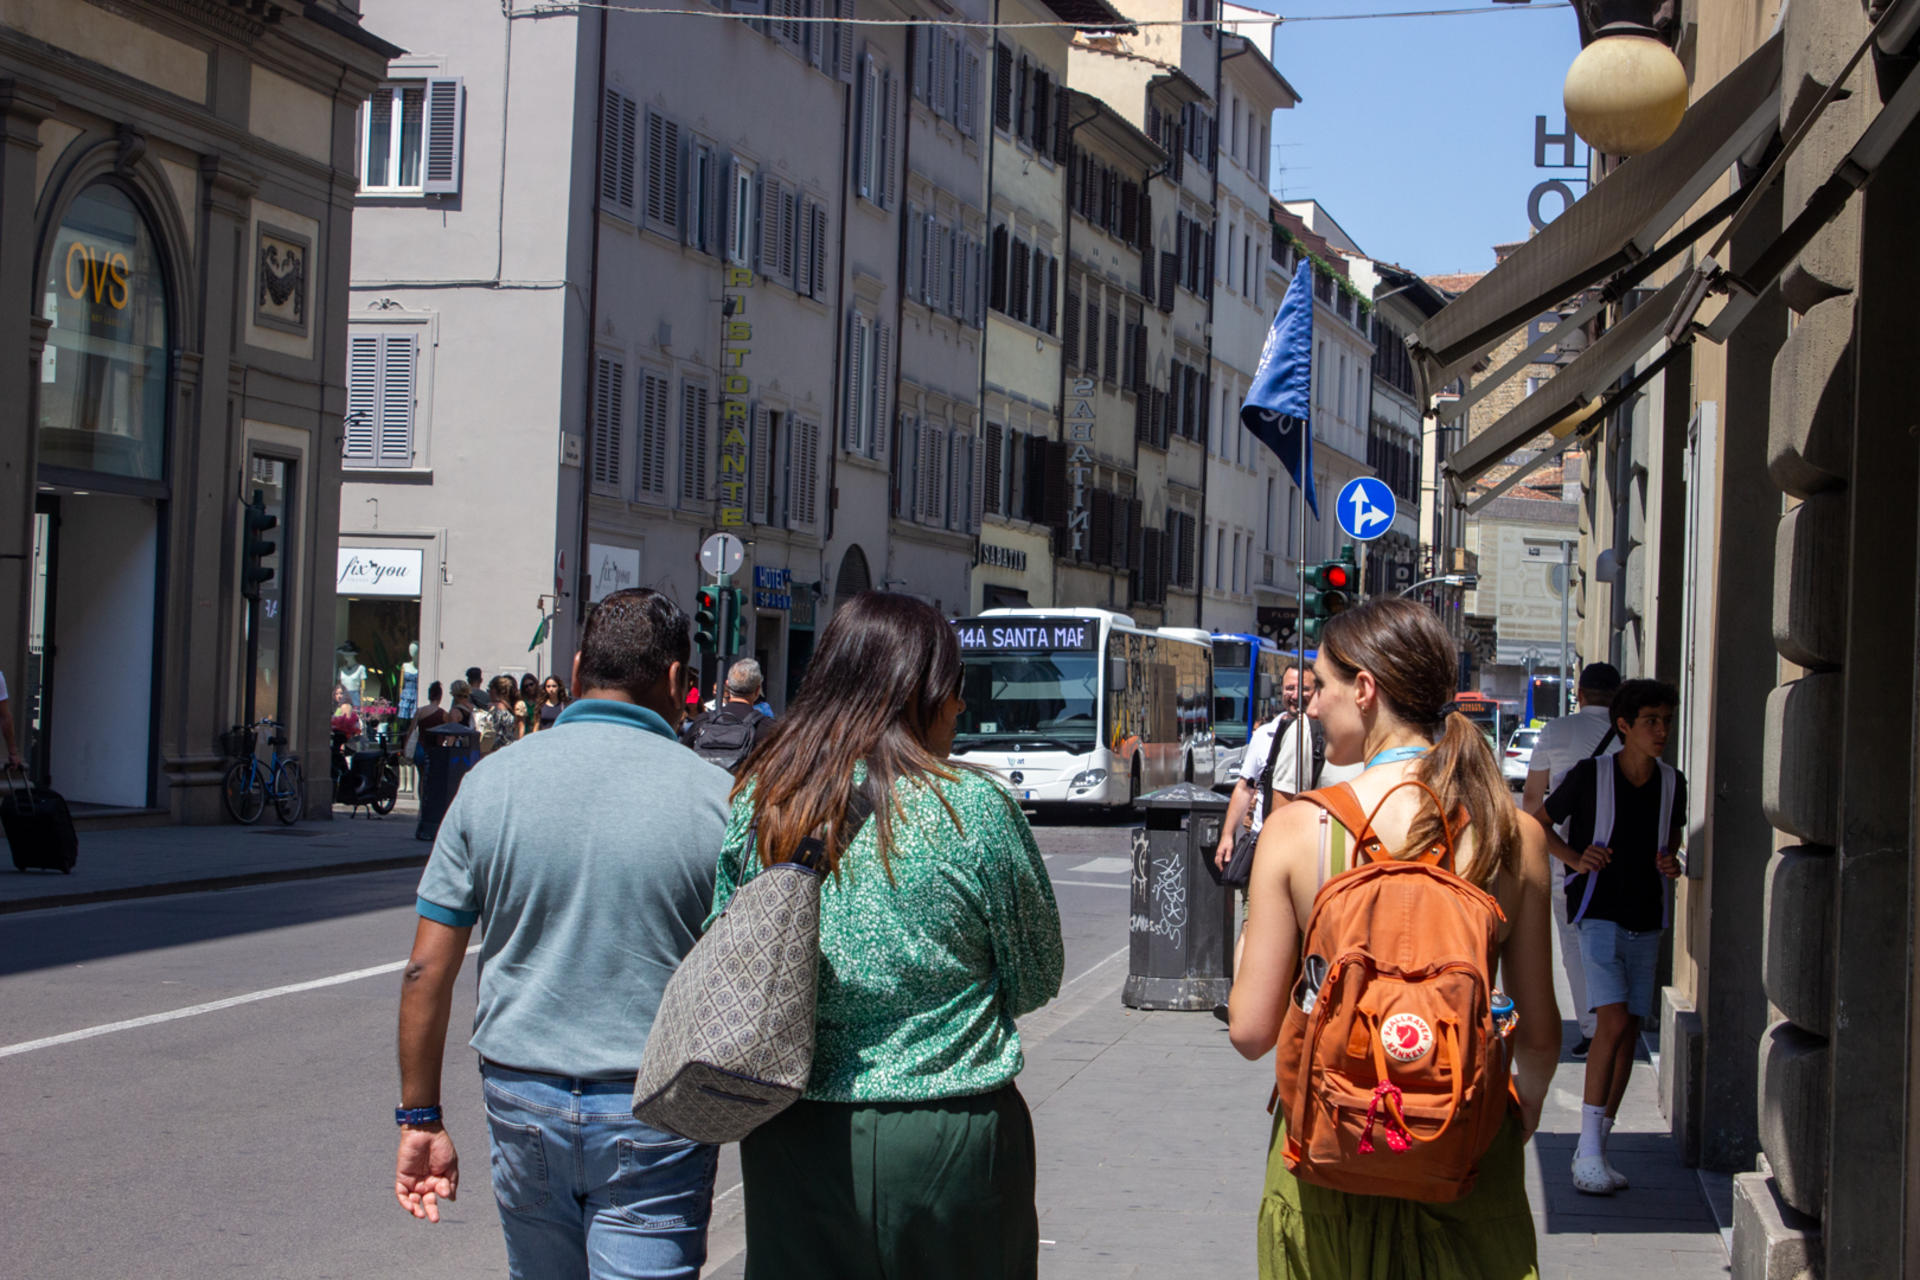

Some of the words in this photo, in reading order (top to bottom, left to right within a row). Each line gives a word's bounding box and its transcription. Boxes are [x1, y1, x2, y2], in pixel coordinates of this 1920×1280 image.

[66, 242, 129, 310] OVS
[722, 268, 752, 527] RISTORANTE
[338, 556, 368, 585] fix
[372, 566, 408, 585] you
[759, 566, 785, 590] HOTEL
[958, 626, 987, 648] 14A
[992, 627, 1049, 648] SANTA
